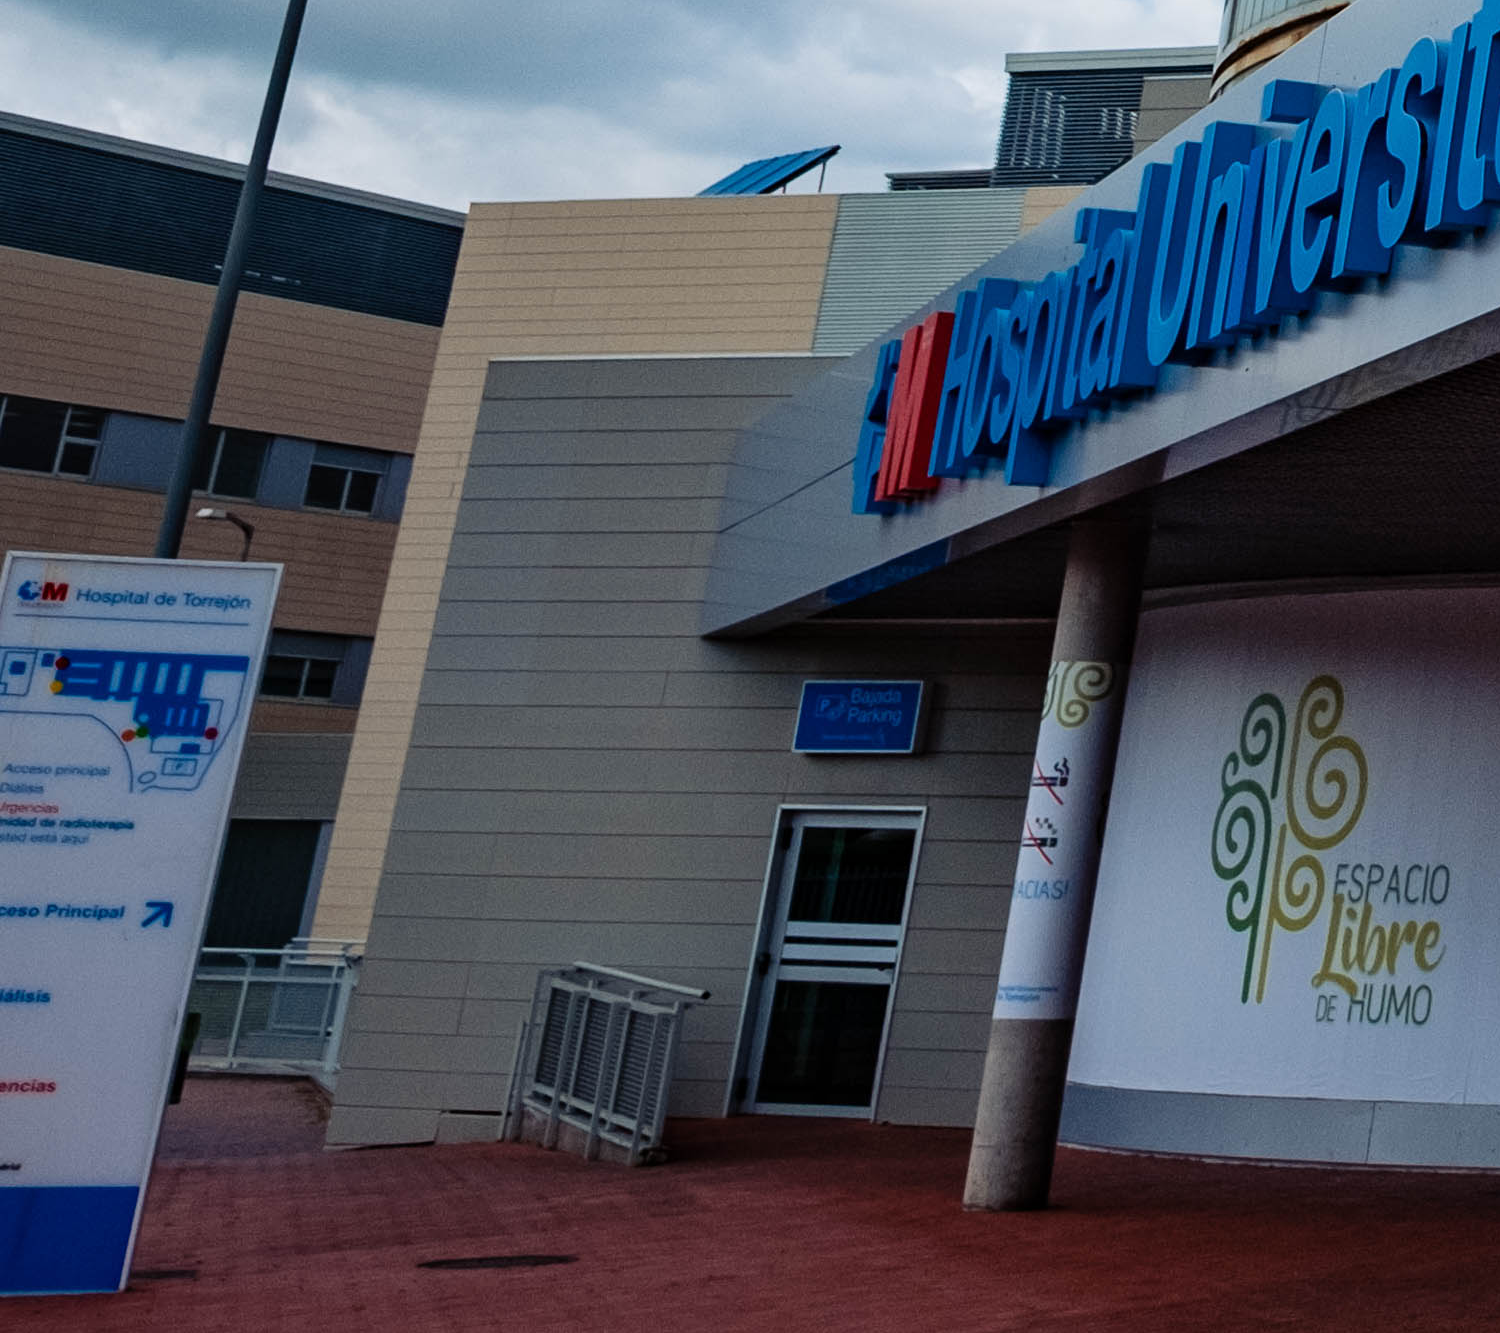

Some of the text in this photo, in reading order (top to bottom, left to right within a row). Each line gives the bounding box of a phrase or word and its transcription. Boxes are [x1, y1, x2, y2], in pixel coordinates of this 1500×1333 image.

[927, 163, 1171, 486] Hospital
[76, 588, 149, 606] Hospital
[154, 590, 177, 606] de
[183, 592, 251, 612] Torrejón
[847, 707, 903, 727] Parking
[4, 763, 111, 777] Acceso principal
[1334, 863, 1450, 905] ESPACIO
[45, 903, 125, 921] Principal
[1311, 891, 1448, 998] Libre
[1315, 983, 1433, 1027] DE HUMO
